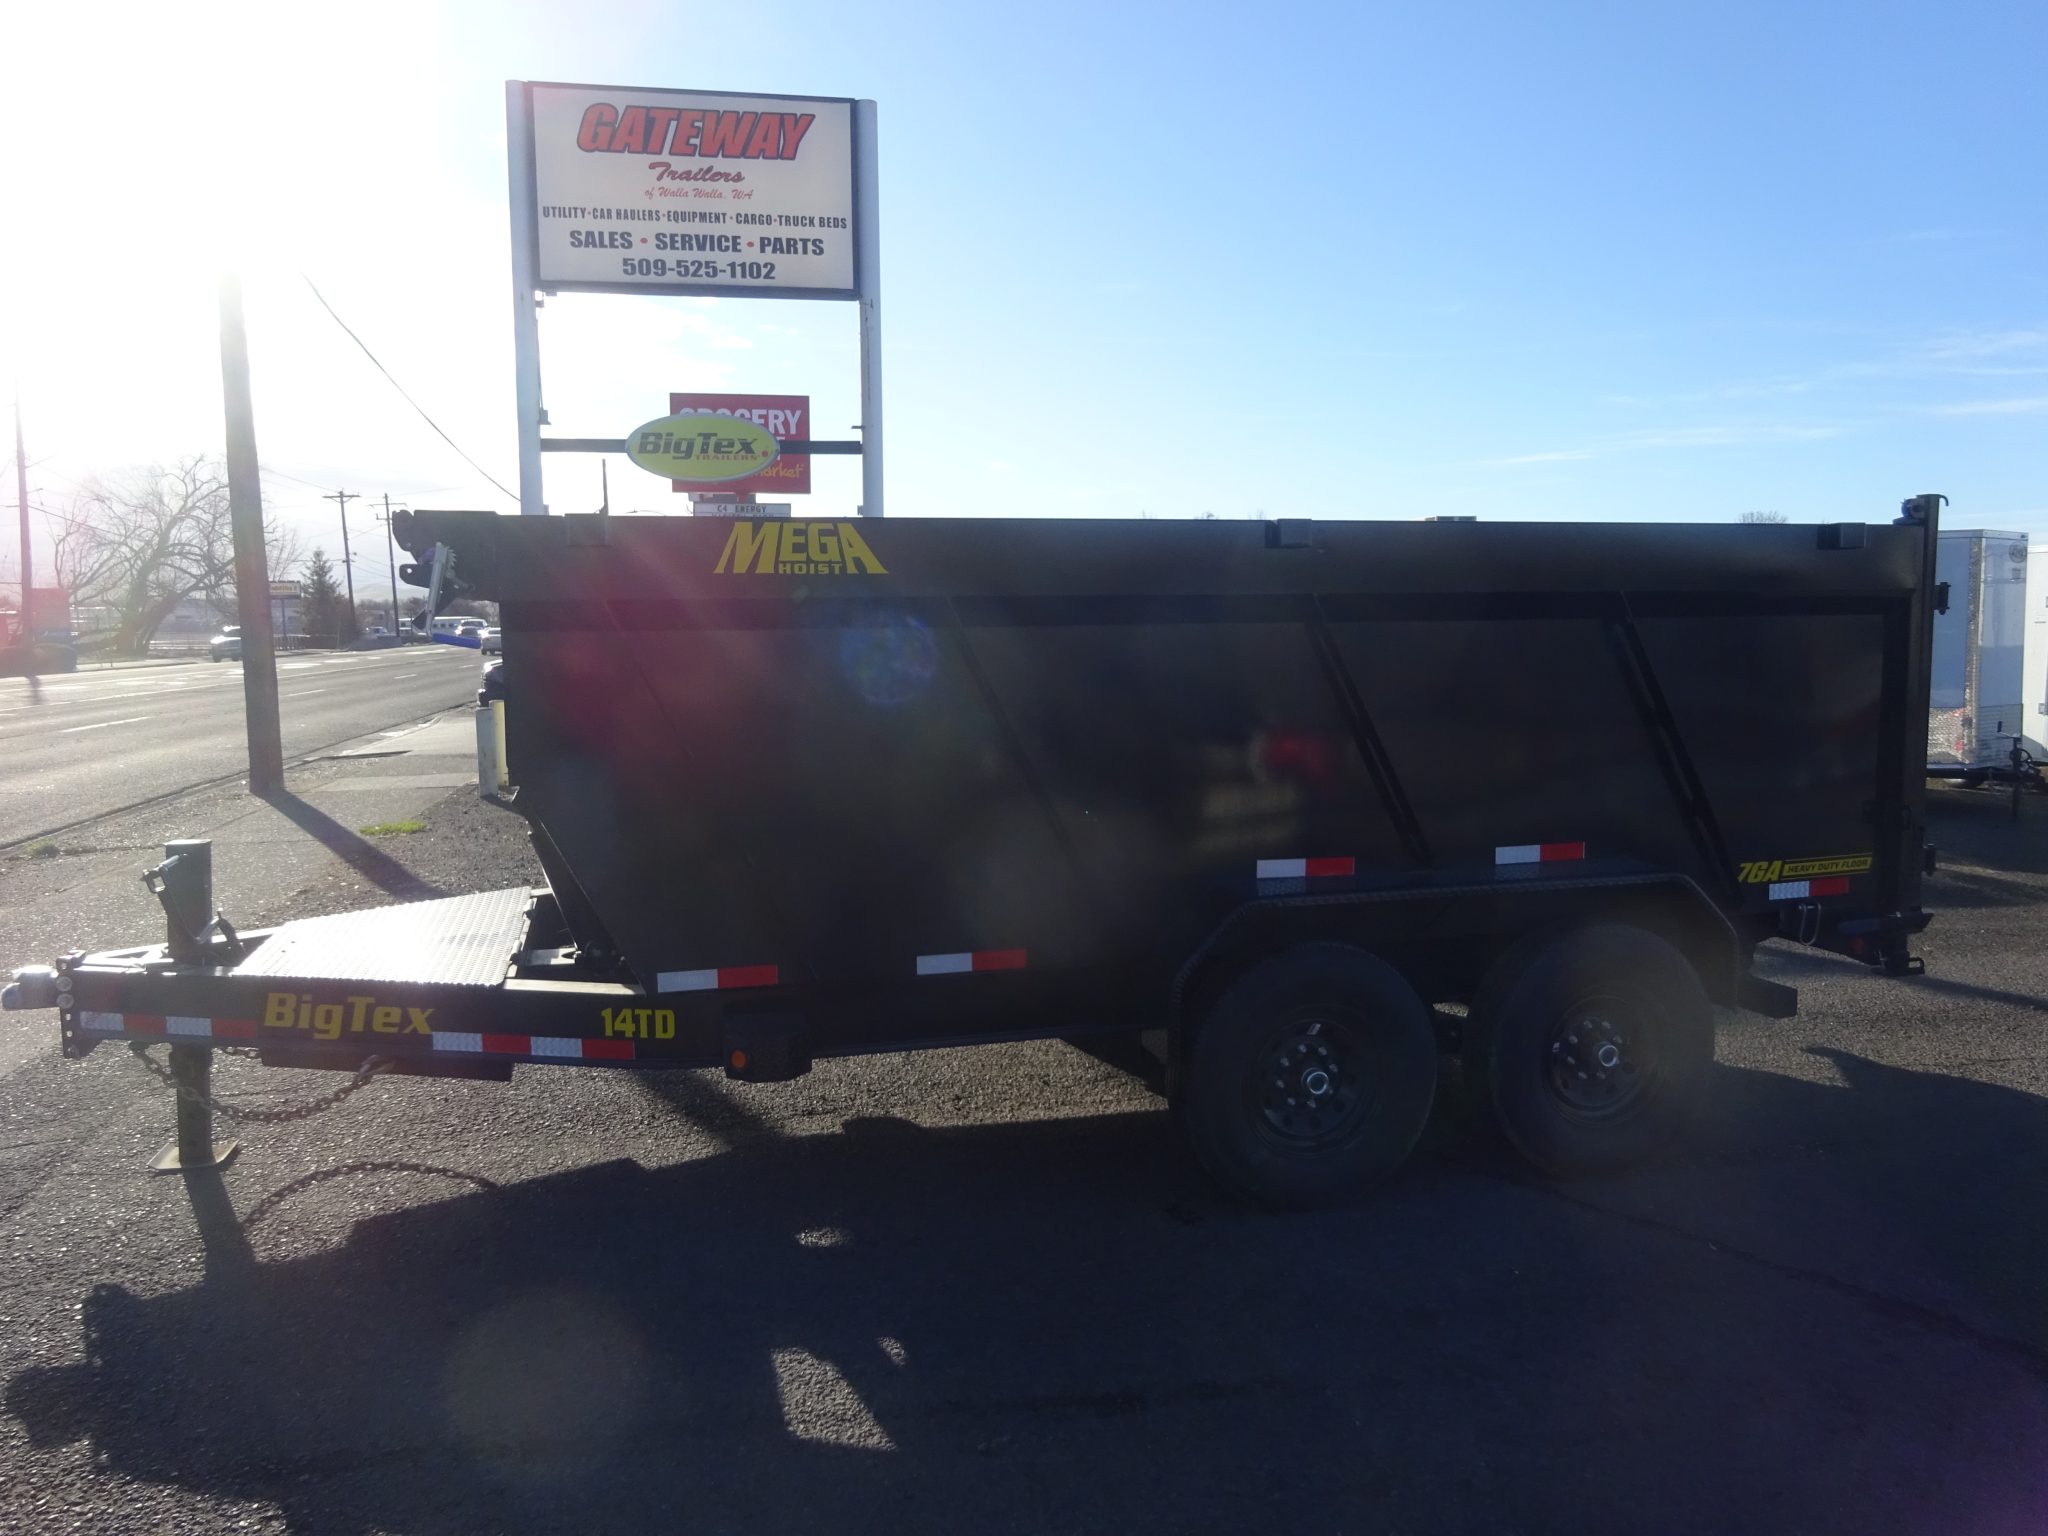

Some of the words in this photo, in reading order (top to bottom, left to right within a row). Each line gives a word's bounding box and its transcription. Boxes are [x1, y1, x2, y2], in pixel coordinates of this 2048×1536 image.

[576, 102, 816, 161] GATEWAY
[648, 161, 746, 183] Trailers
[645, 187, 655, 200] of
[658, 187, 689, 198] Walla
[732, 189, 755, 200] WA
[543, 206, 587, 218] UTILITY
[592, 207, 613, 220] CAR
[616, 209, 661, 222] HAULERS
[667, 210, 727, 224] EQUIPMENT
[736, 213, 772, 226] CARGO
[777, 215, 816, 228] TRUCK
[819, 217, 848, 229] BEDS
[569, 230, 633, 250] SALES
[655, 232, 742, 253] SERVICE
[759, 236, 825, 256] PARTS
[622, 257, 776, 280] 509-525-1102
[637, 432, 758, 460] BigTex
[753, 460, 803, 478] arket
[713, 521, 889, 574] MEGA
[779, 563, 843, 575] HOIST
[1737, 860, 1782, 883] 7GA
[1787, 862, 1817, 873] HEAVY
[1817, 861, 1840, 871] DUTY
[1841, 858, 1868, 869] FLOOR
[264, 992, 435, 1040] BigTex
[601, 1007, 675, 1039] 14TD
